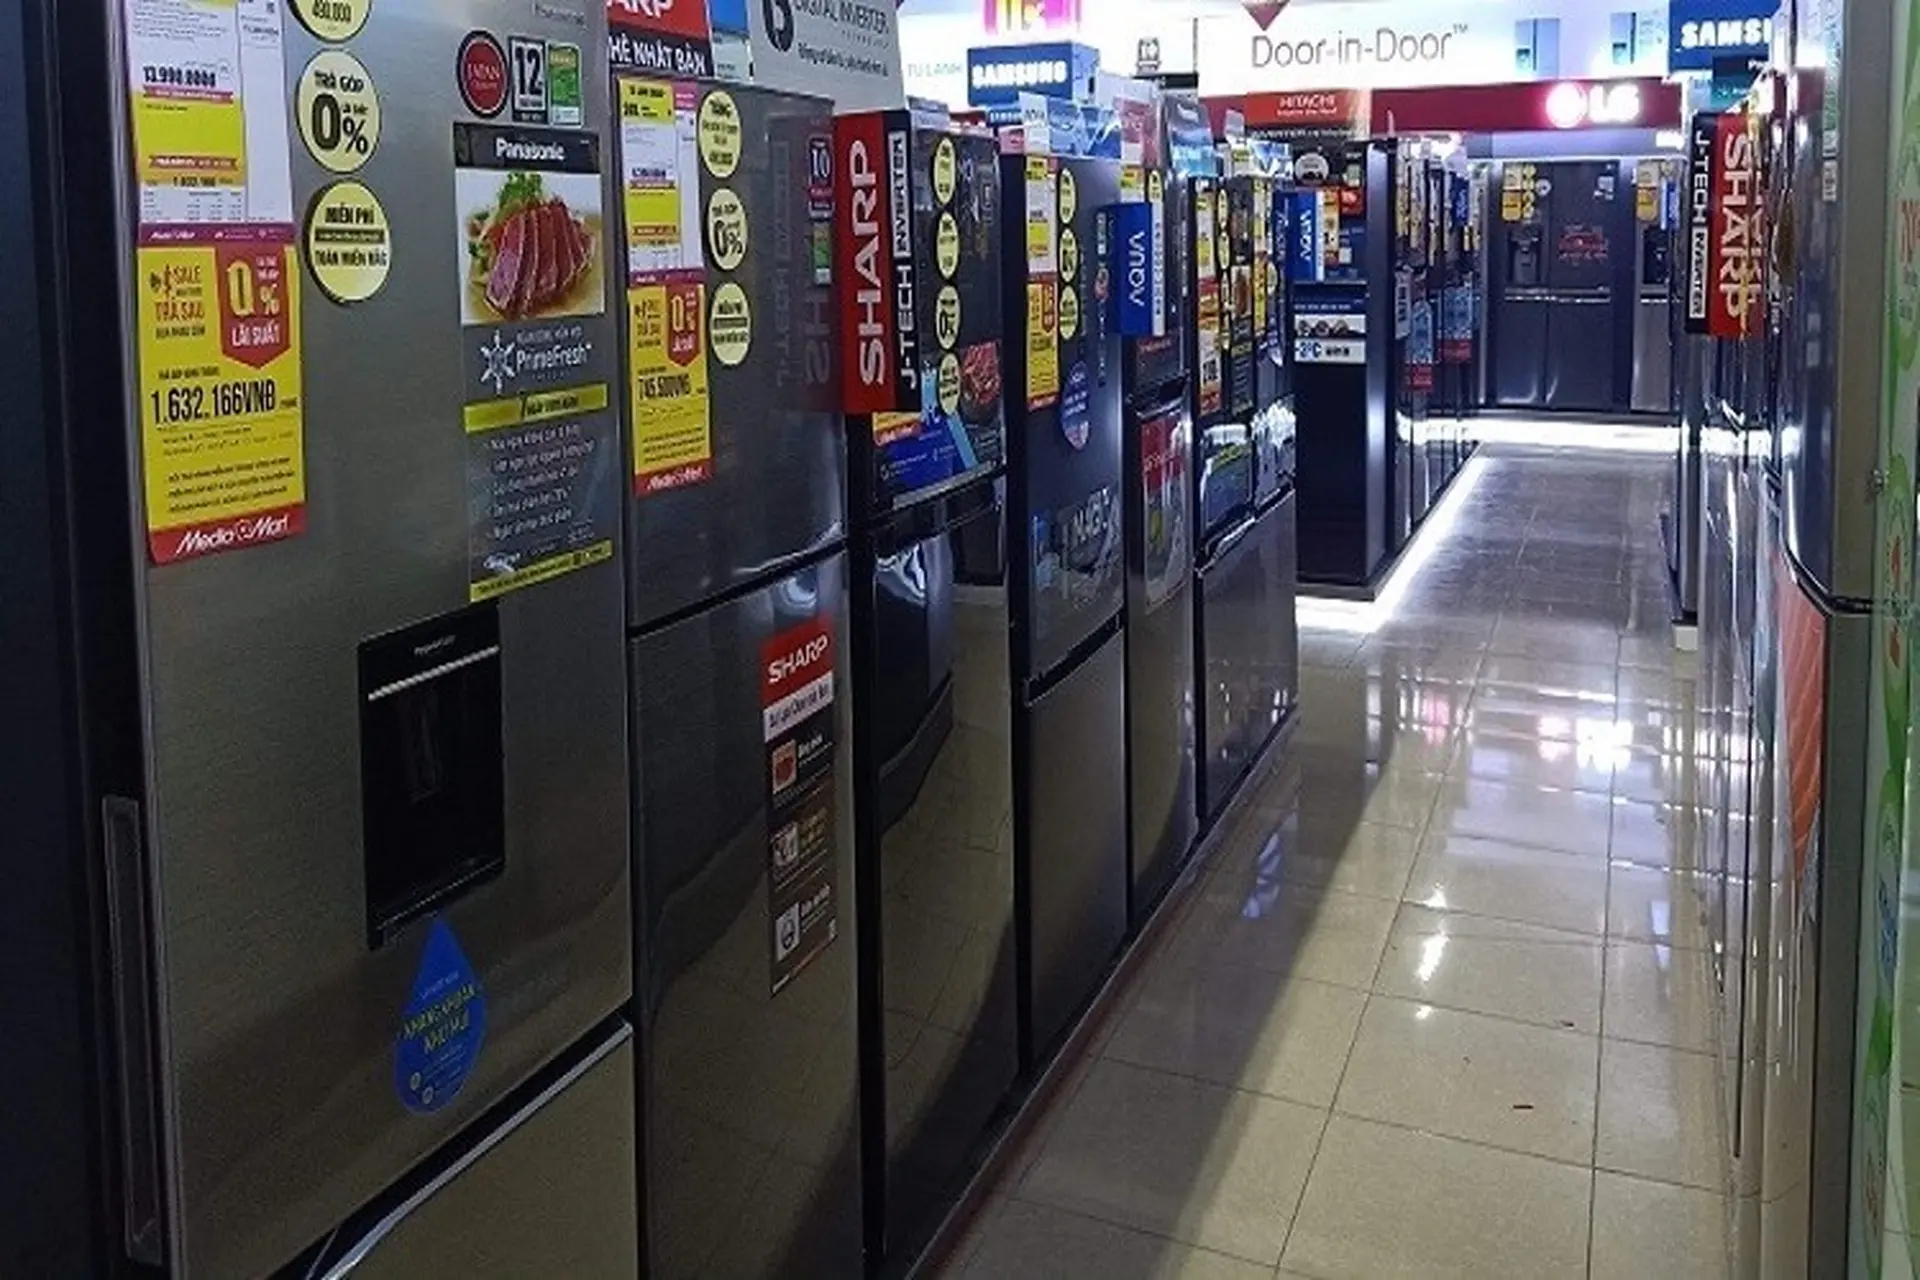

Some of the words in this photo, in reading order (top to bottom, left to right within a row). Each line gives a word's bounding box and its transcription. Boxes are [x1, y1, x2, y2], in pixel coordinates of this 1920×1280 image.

[607, 0, 672, 18] ARP
[1680, 18, 1772, 49] SAMS
[515, 46, 543, 97] 12
[970, 60, 1068, 88] SAMSUNG
[1278, 93, 1336, 109] HITACHI
[1589, 83, 1640, 124] LG
[495, 136, 566, 162] Panasonic
[1692, 130, 1710, 224] J-TECH
[1719, 133, 1751, 319] SHARP
[850, 138, 885, 386] SHARP
[1128, 229, 1146, 307] AQUA
[898, 264, 917, 390] J-TECH
[175, 527, 235, 556] Media
[249, 513, 289, 542] Mart
[767, 634, 829, 685] SHARP
